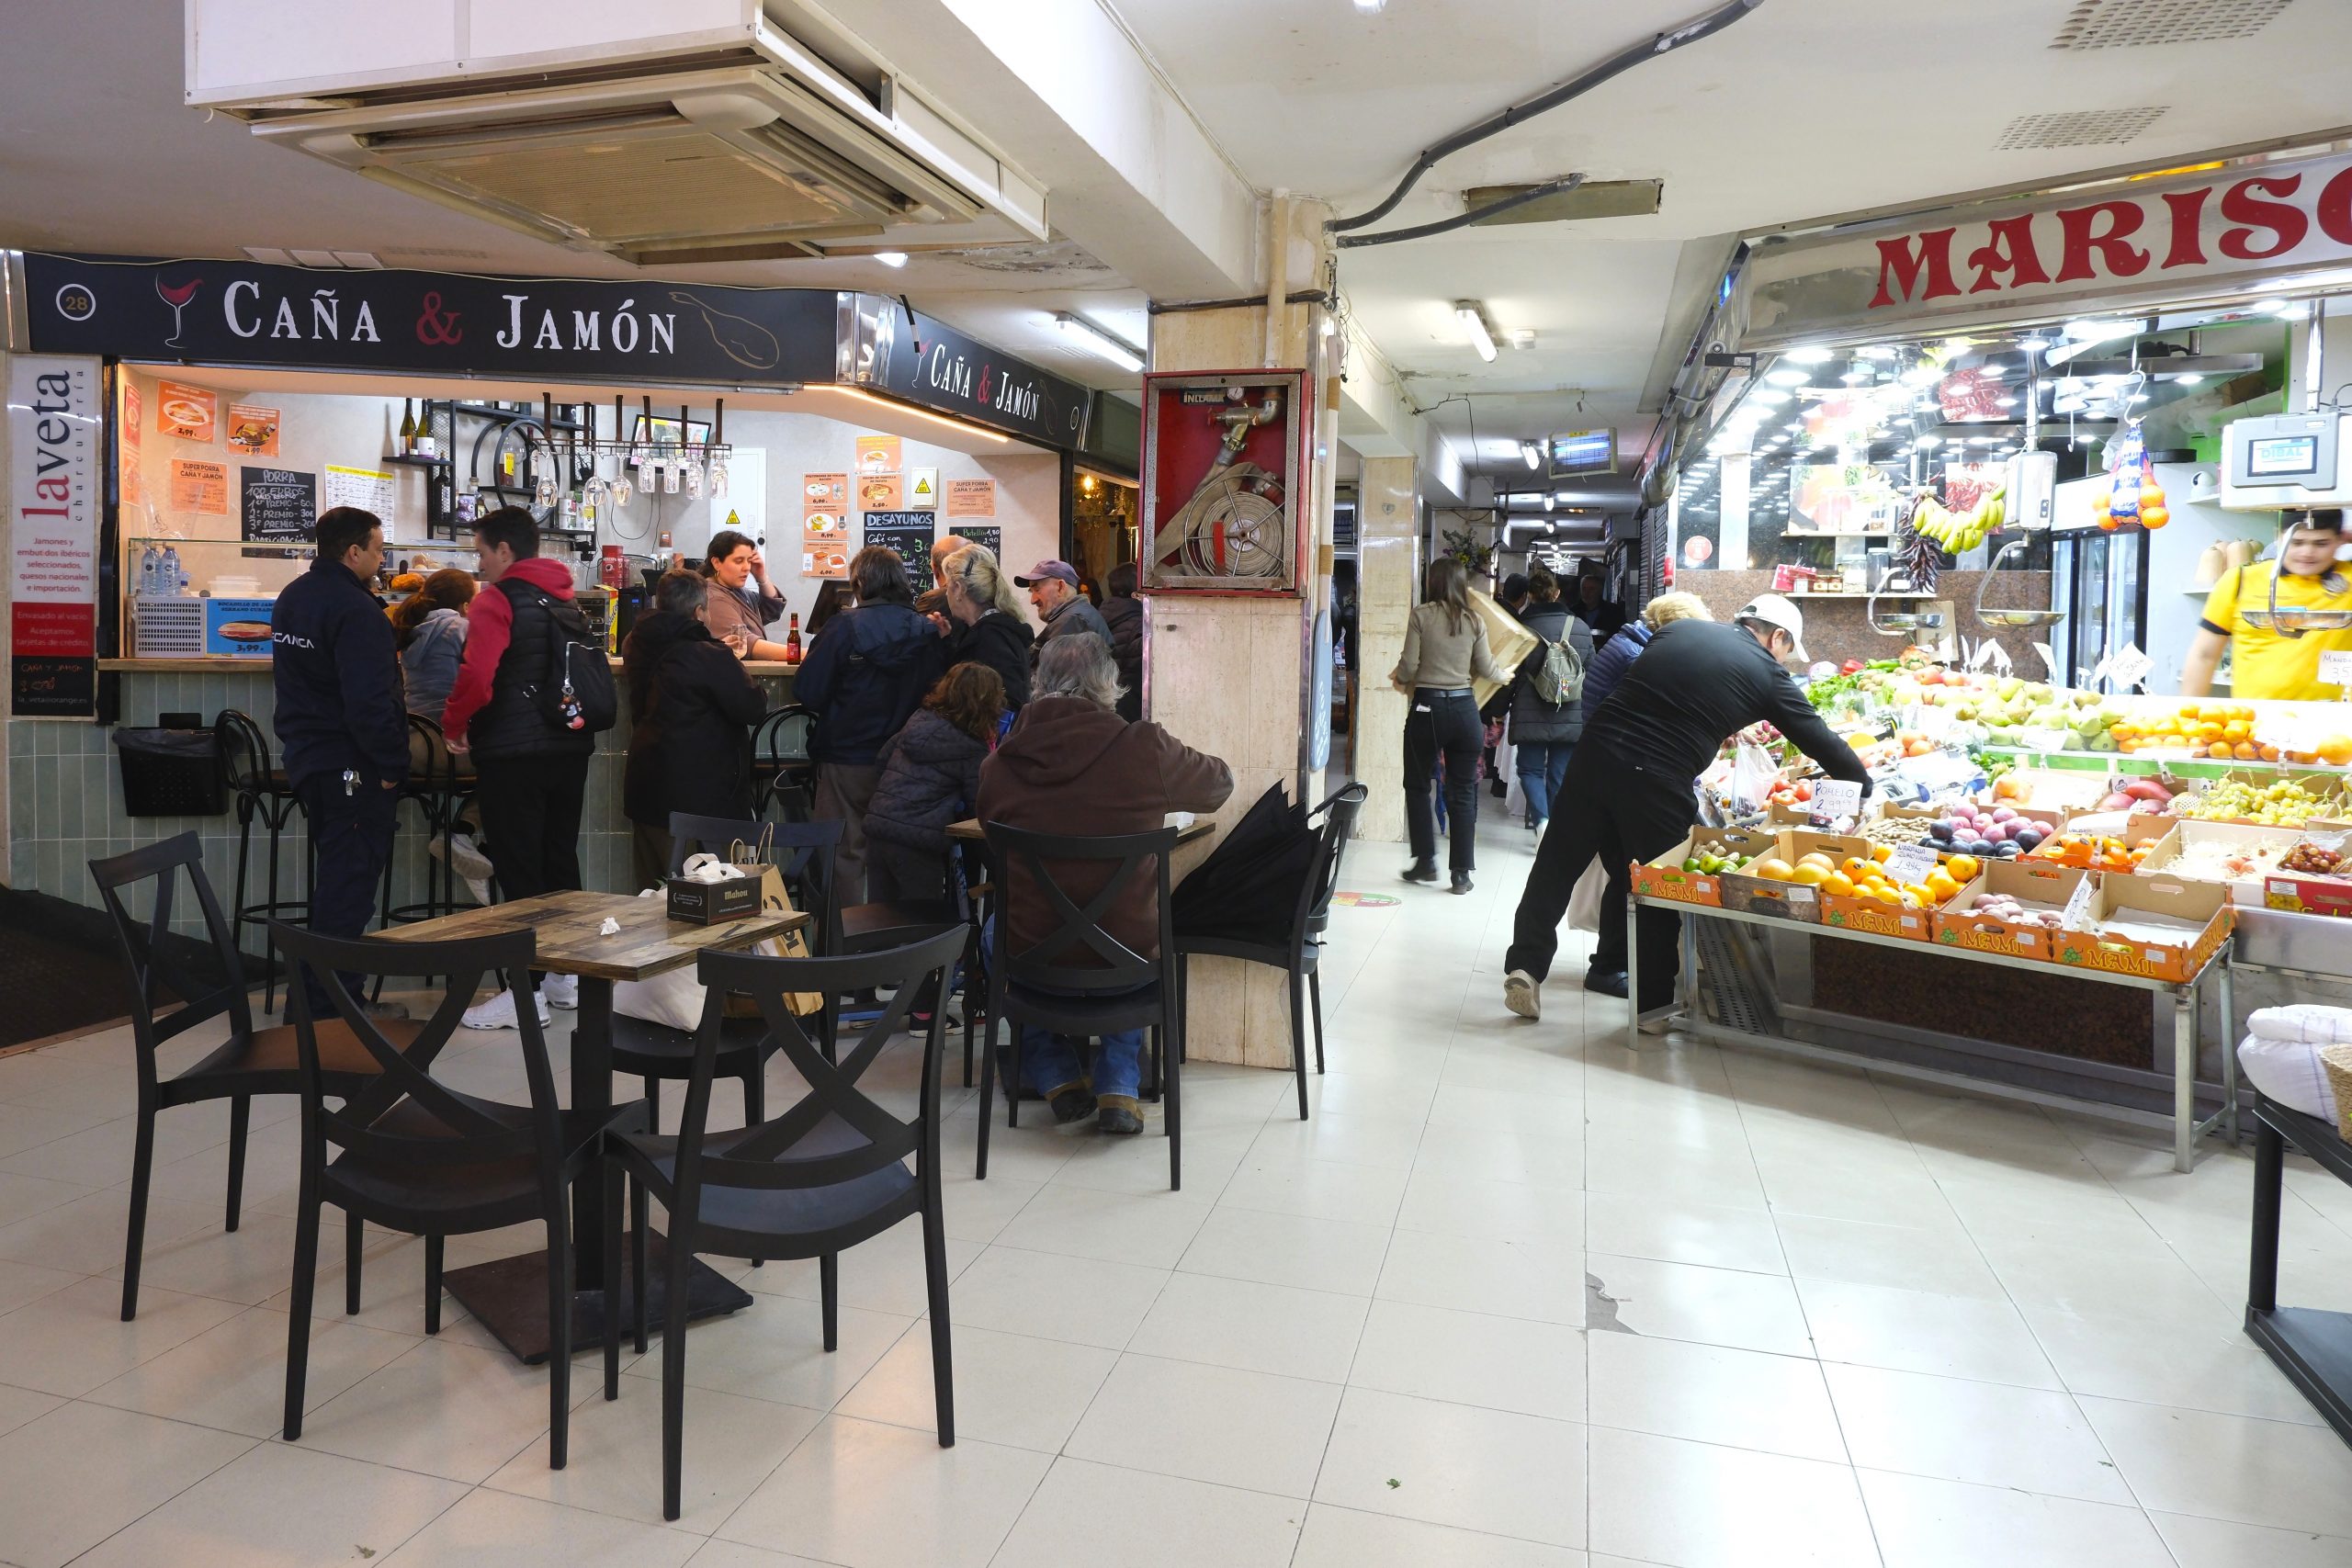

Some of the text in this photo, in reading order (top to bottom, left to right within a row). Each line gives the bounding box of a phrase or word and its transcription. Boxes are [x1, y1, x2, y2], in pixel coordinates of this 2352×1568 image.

[65, 296, 89, 311] 28
[223, 279, 676, 355] CAÑA & JAMÓN
[977, 364, 992, 405] &
[995, 370, 1040, 423] JAMÓN
[2261, 447, 2304, 458] DIBAL
[182, 462, 220, 472] SUPER PORRA
[263, 469, 297, 484] PORRA
[245, 487, 306, 497] 100 EUROS
[266, 499, 293, 509] PREMIO
[263, 507, 294, 519] PREMIO
[264, 518, 294, 528] PREMIO
[866, 513, 933, 527] DESAYUNOS
[33, 537, 68, 546] Jamones
[867, 533, 886, 544] Café
[60, 549, 91, 558] ibéricos
[27, 561, 83, 570] seleccionados,
[49, 573, 89, 581] nacionales
[17, 612, 56, 620] Envasado
[29, 626, 75, 636] Aceptamos
[235, 644, 259, 652] 3,99
[1815, 782, 1855, 798] POMELO
[724, 888, 748, 900] Mahou
[1655, 881, 1702, 903] MAMI
[1849, 912, 1905, 936] MAMI
[1963, 930, 2025, 955] MAMI
[2087, 949, 2155, 976] MAMI
